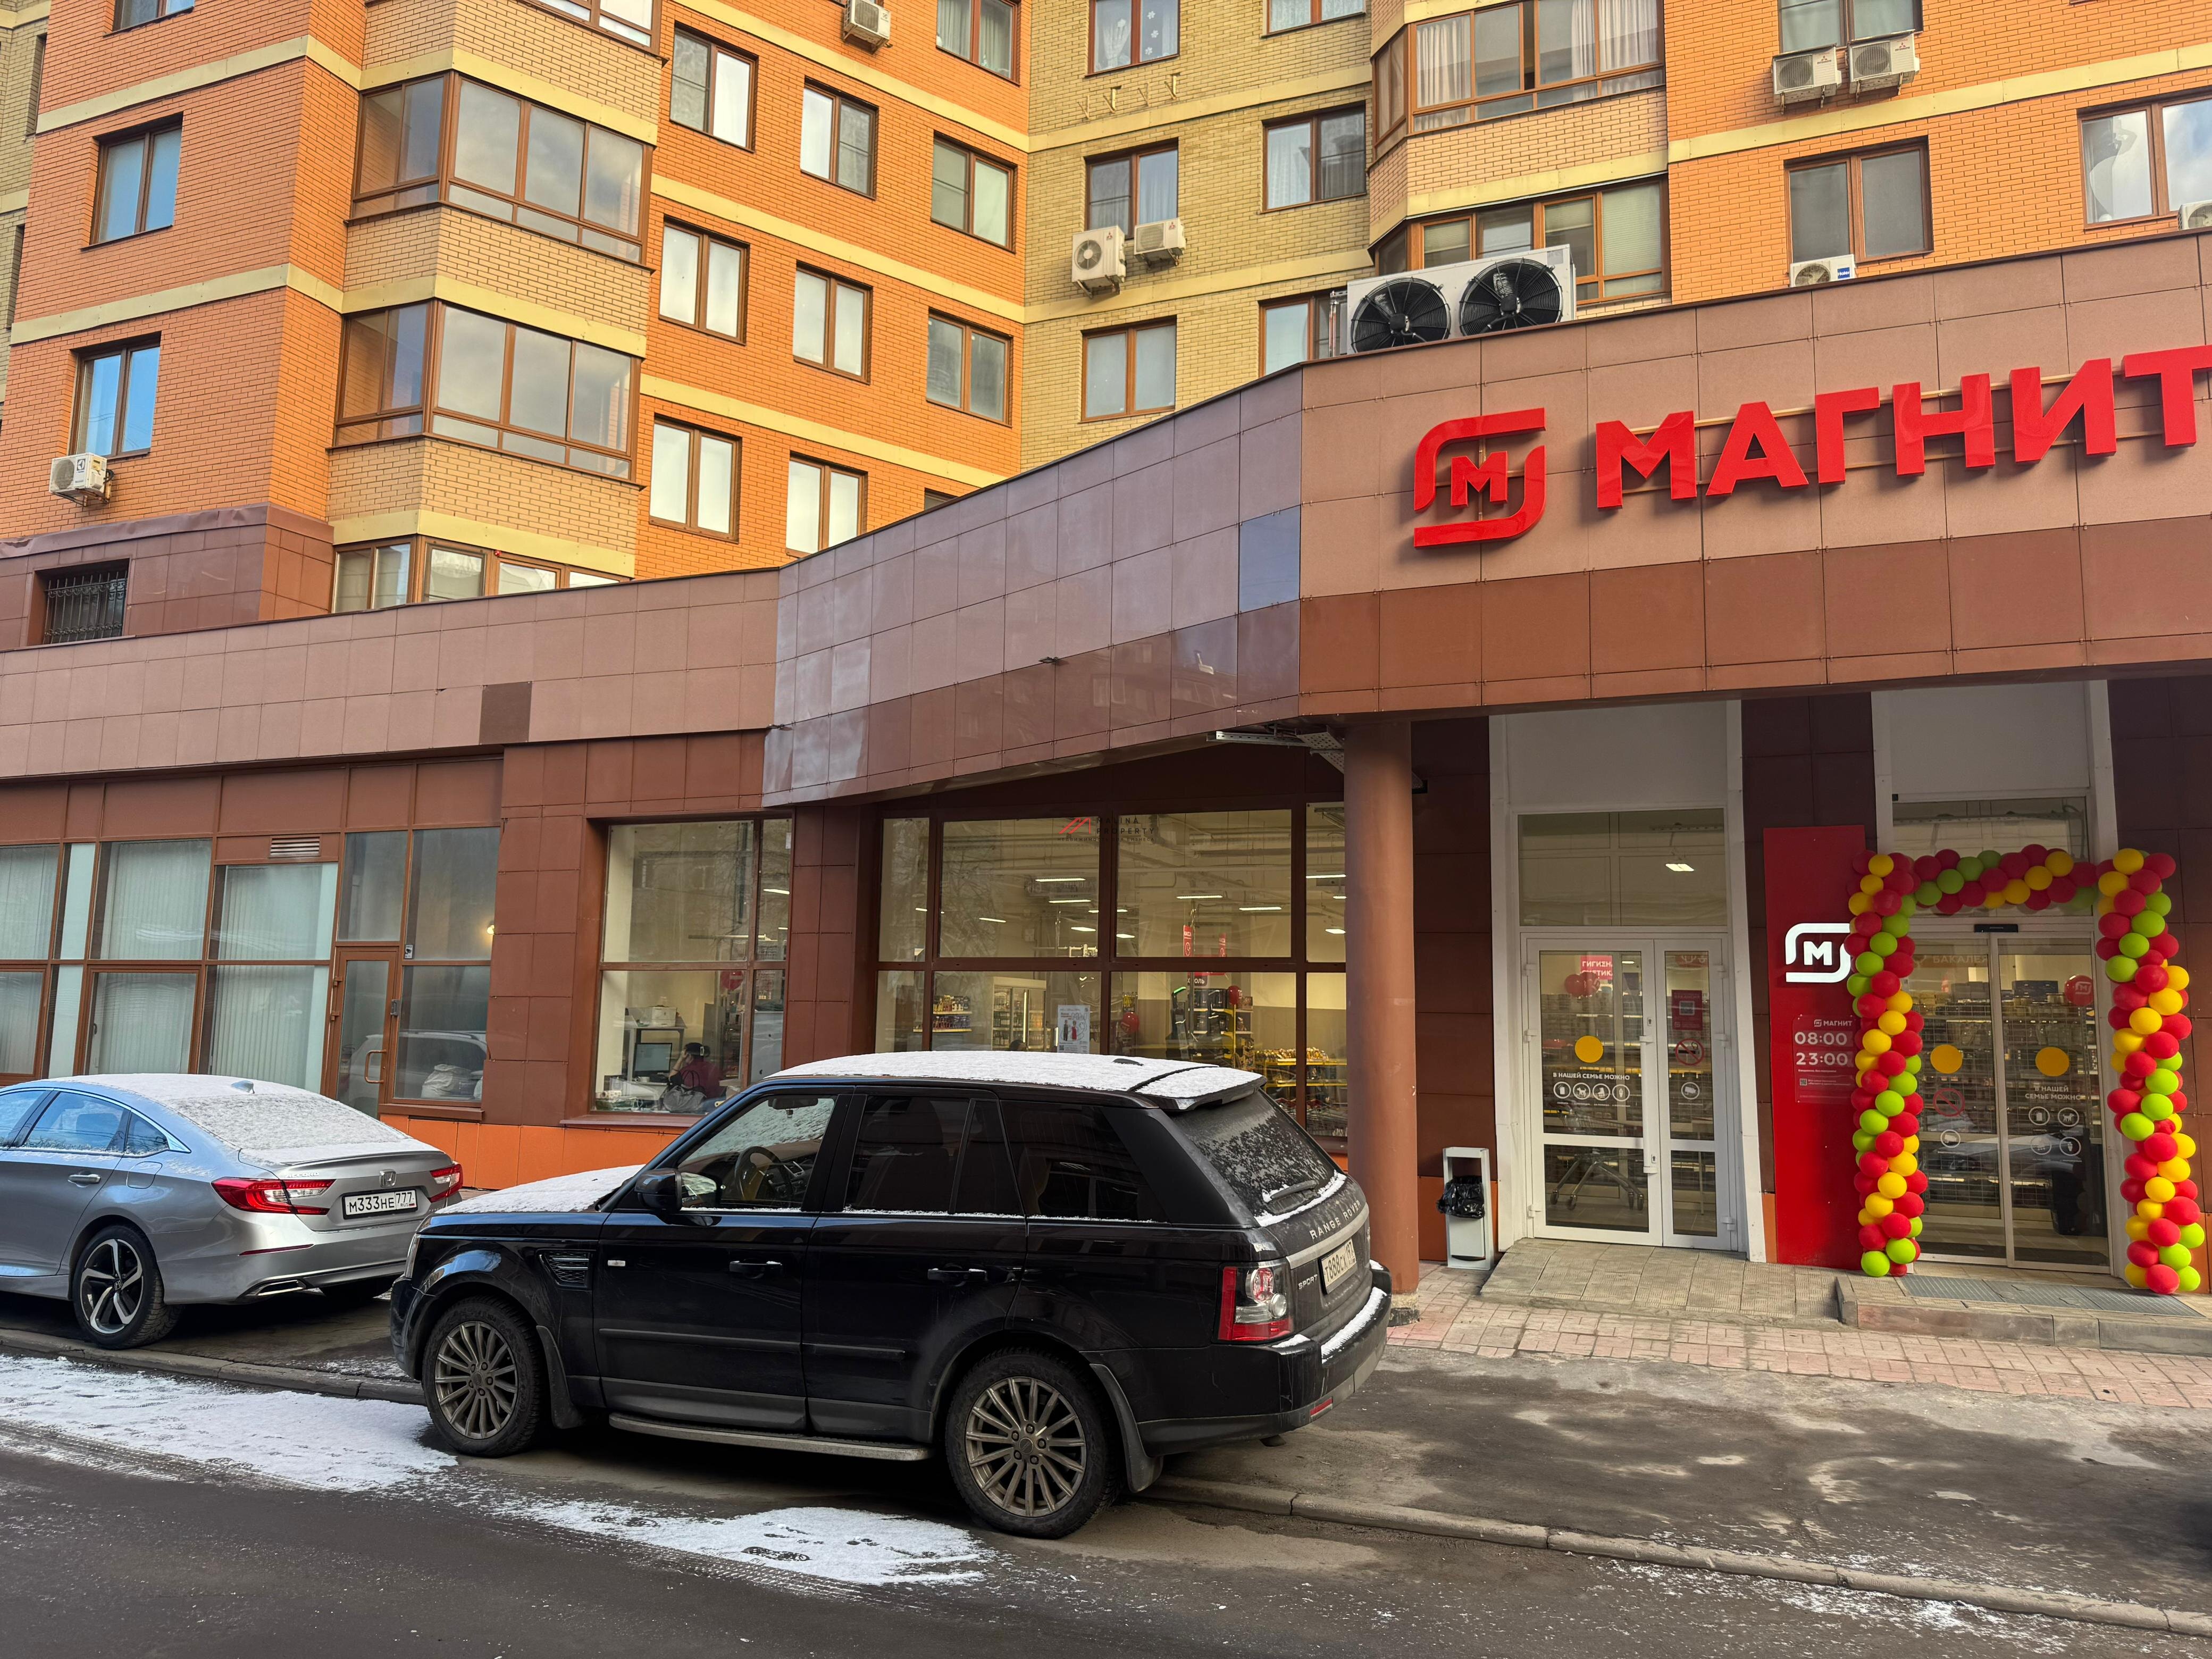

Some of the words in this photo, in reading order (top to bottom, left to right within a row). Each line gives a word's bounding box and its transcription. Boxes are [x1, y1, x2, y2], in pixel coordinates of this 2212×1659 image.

[1595, 345, 2212, 509] МАГНИТ
[1795, 1032, 1847, 1045] 08:00
[1796, 1052, 1848, 1066] 23:00
[396, 1192, 413, 1204] 777
[1309, 1217, 1341, 1240] RANGE
[1343, 1200, 1361, 1221] ROVER
[1298, 1274, 1318, 1289] SPORT
